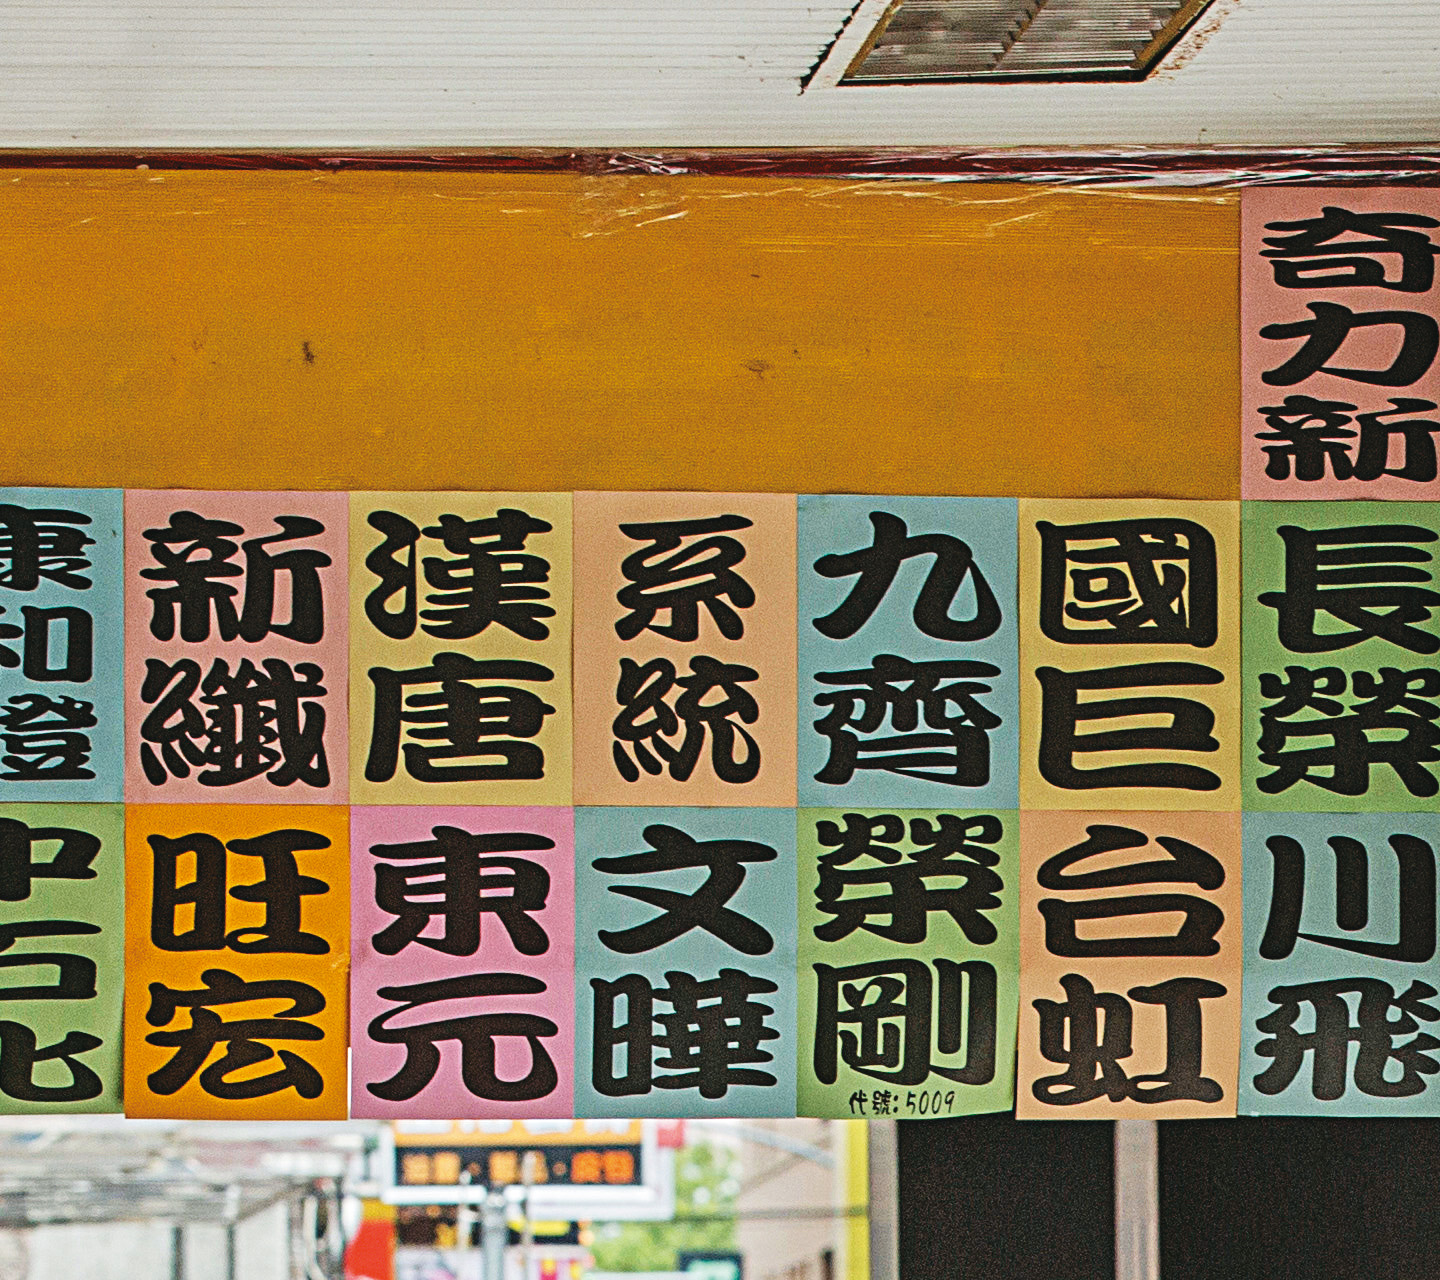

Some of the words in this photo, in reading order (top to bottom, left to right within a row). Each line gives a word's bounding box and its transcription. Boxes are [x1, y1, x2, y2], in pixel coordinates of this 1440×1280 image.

[140, 511, 331, 787] 新纖
[365, 509, 555, 782] 漢唐
[613, 515, 760, 783] 系統
[813, 512, 1001, 786] 九齊
[1036, 519, 1224, 790] 國巨
[146, 830, 331, 1099] 旺宏
[367, 826, 557, 1101] 東元
[813, 814, 1003, 1085] 榮剛
[1033, 825, 1226, 1105] 台虹
